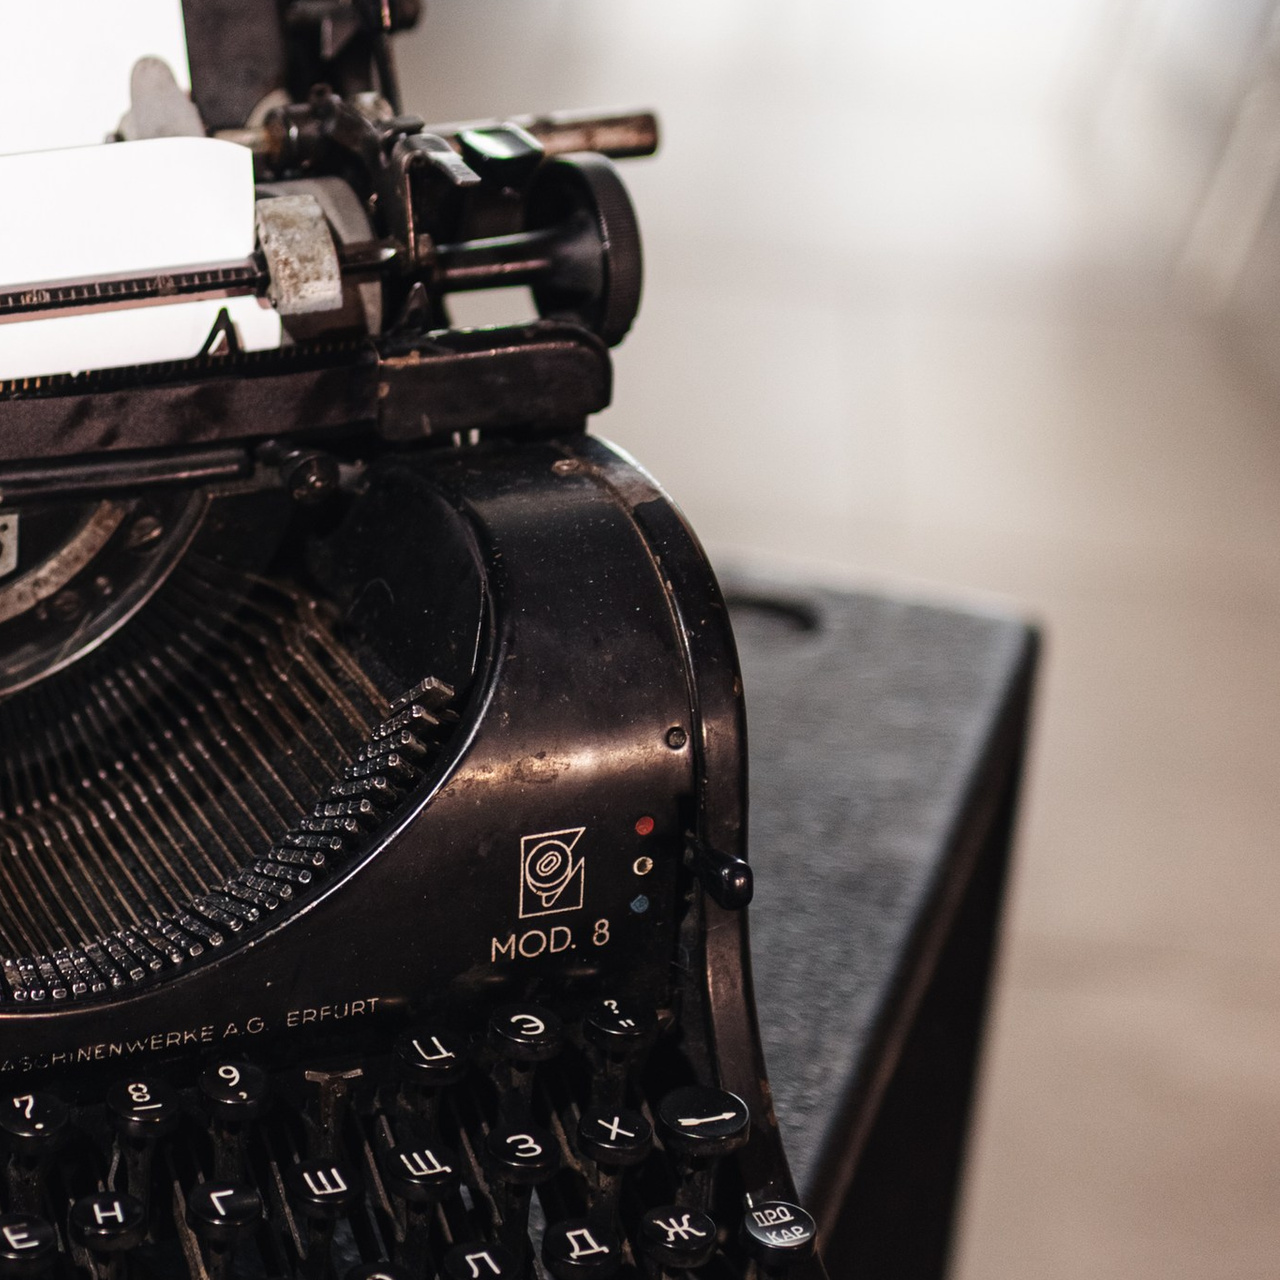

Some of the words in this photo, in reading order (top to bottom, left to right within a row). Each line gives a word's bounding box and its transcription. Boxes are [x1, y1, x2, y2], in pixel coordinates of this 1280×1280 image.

[491, 926, 577, 963] MOD.
[592, 918, 610, 946] 8
[286, 997, 380, 1027] ERFURT
[510, 1014, 545, 1035] Э
[412, 1036, 455, 1061] Ц
[218, 1065, 240, 1087] 9
[127, 1083, 151, 1103] 8
[13, 1094, 34, 1119] 7
[597, 1116, 635, 1141] Х
[399, 1149, 452, 1176] Щ
[303, 1167, 348, 1195] Ш
[93, 1201, 124, 1225] Н
[209, 1189, 234, 1216] Г
[653, 1213, 707, 1242] Ж
[752, 1207, 795, 1227] ПРО
[2, 1223, 39, 1249] Е
[565, 1228, 610, 1260] Д
[765, 1225, 810, 1243] КАР
[465, 1251, 501, 1279] Л
